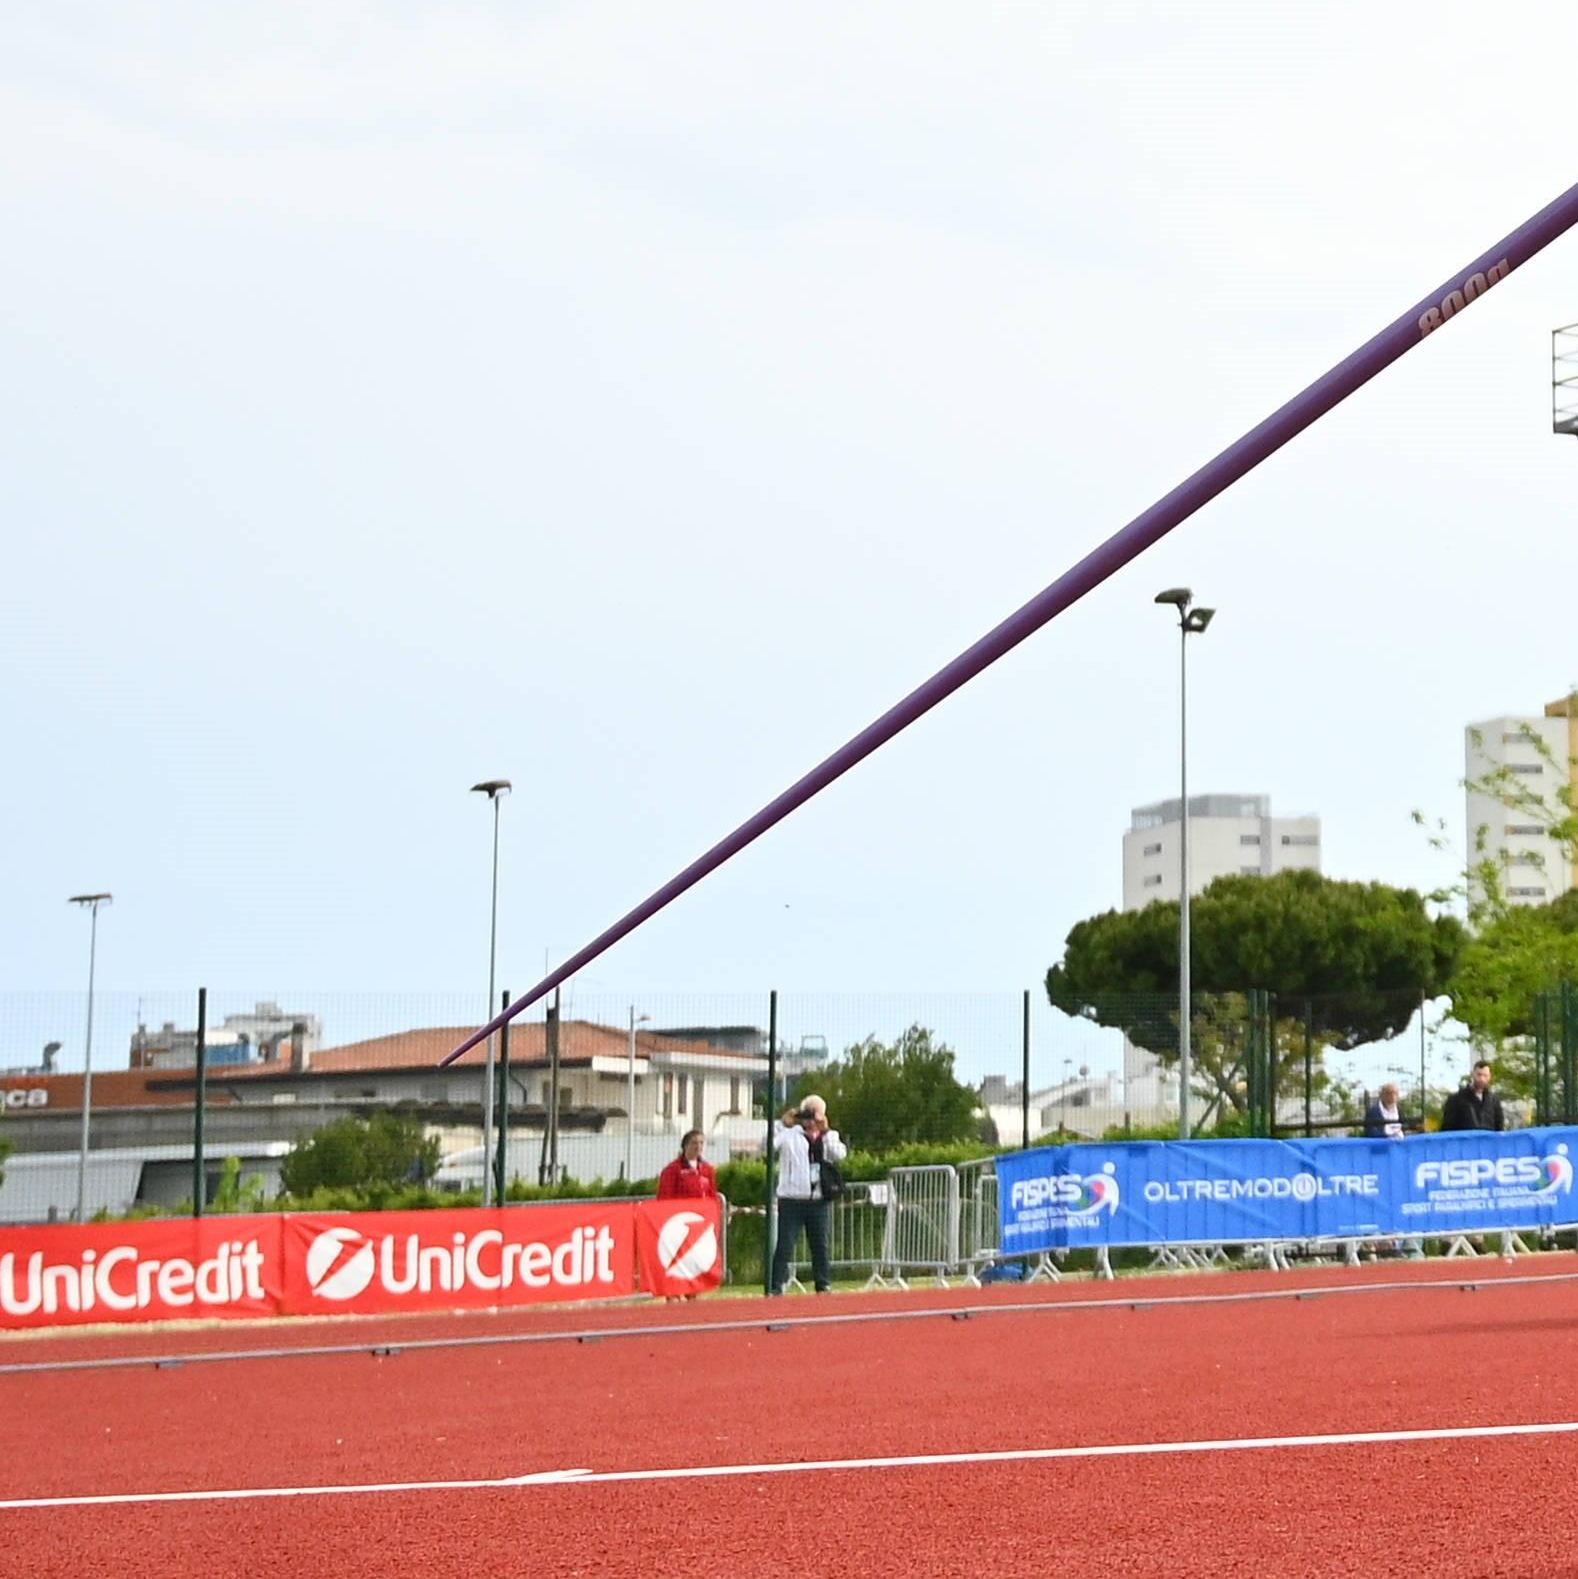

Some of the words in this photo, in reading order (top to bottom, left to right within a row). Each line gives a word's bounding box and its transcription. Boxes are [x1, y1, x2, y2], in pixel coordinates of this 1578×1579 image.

[1415, 1156, 1541, 1188] FISPES
[0, 1240, 265, 1315] UniCredit
[380, 1225, 615, 1295] UniCredit
